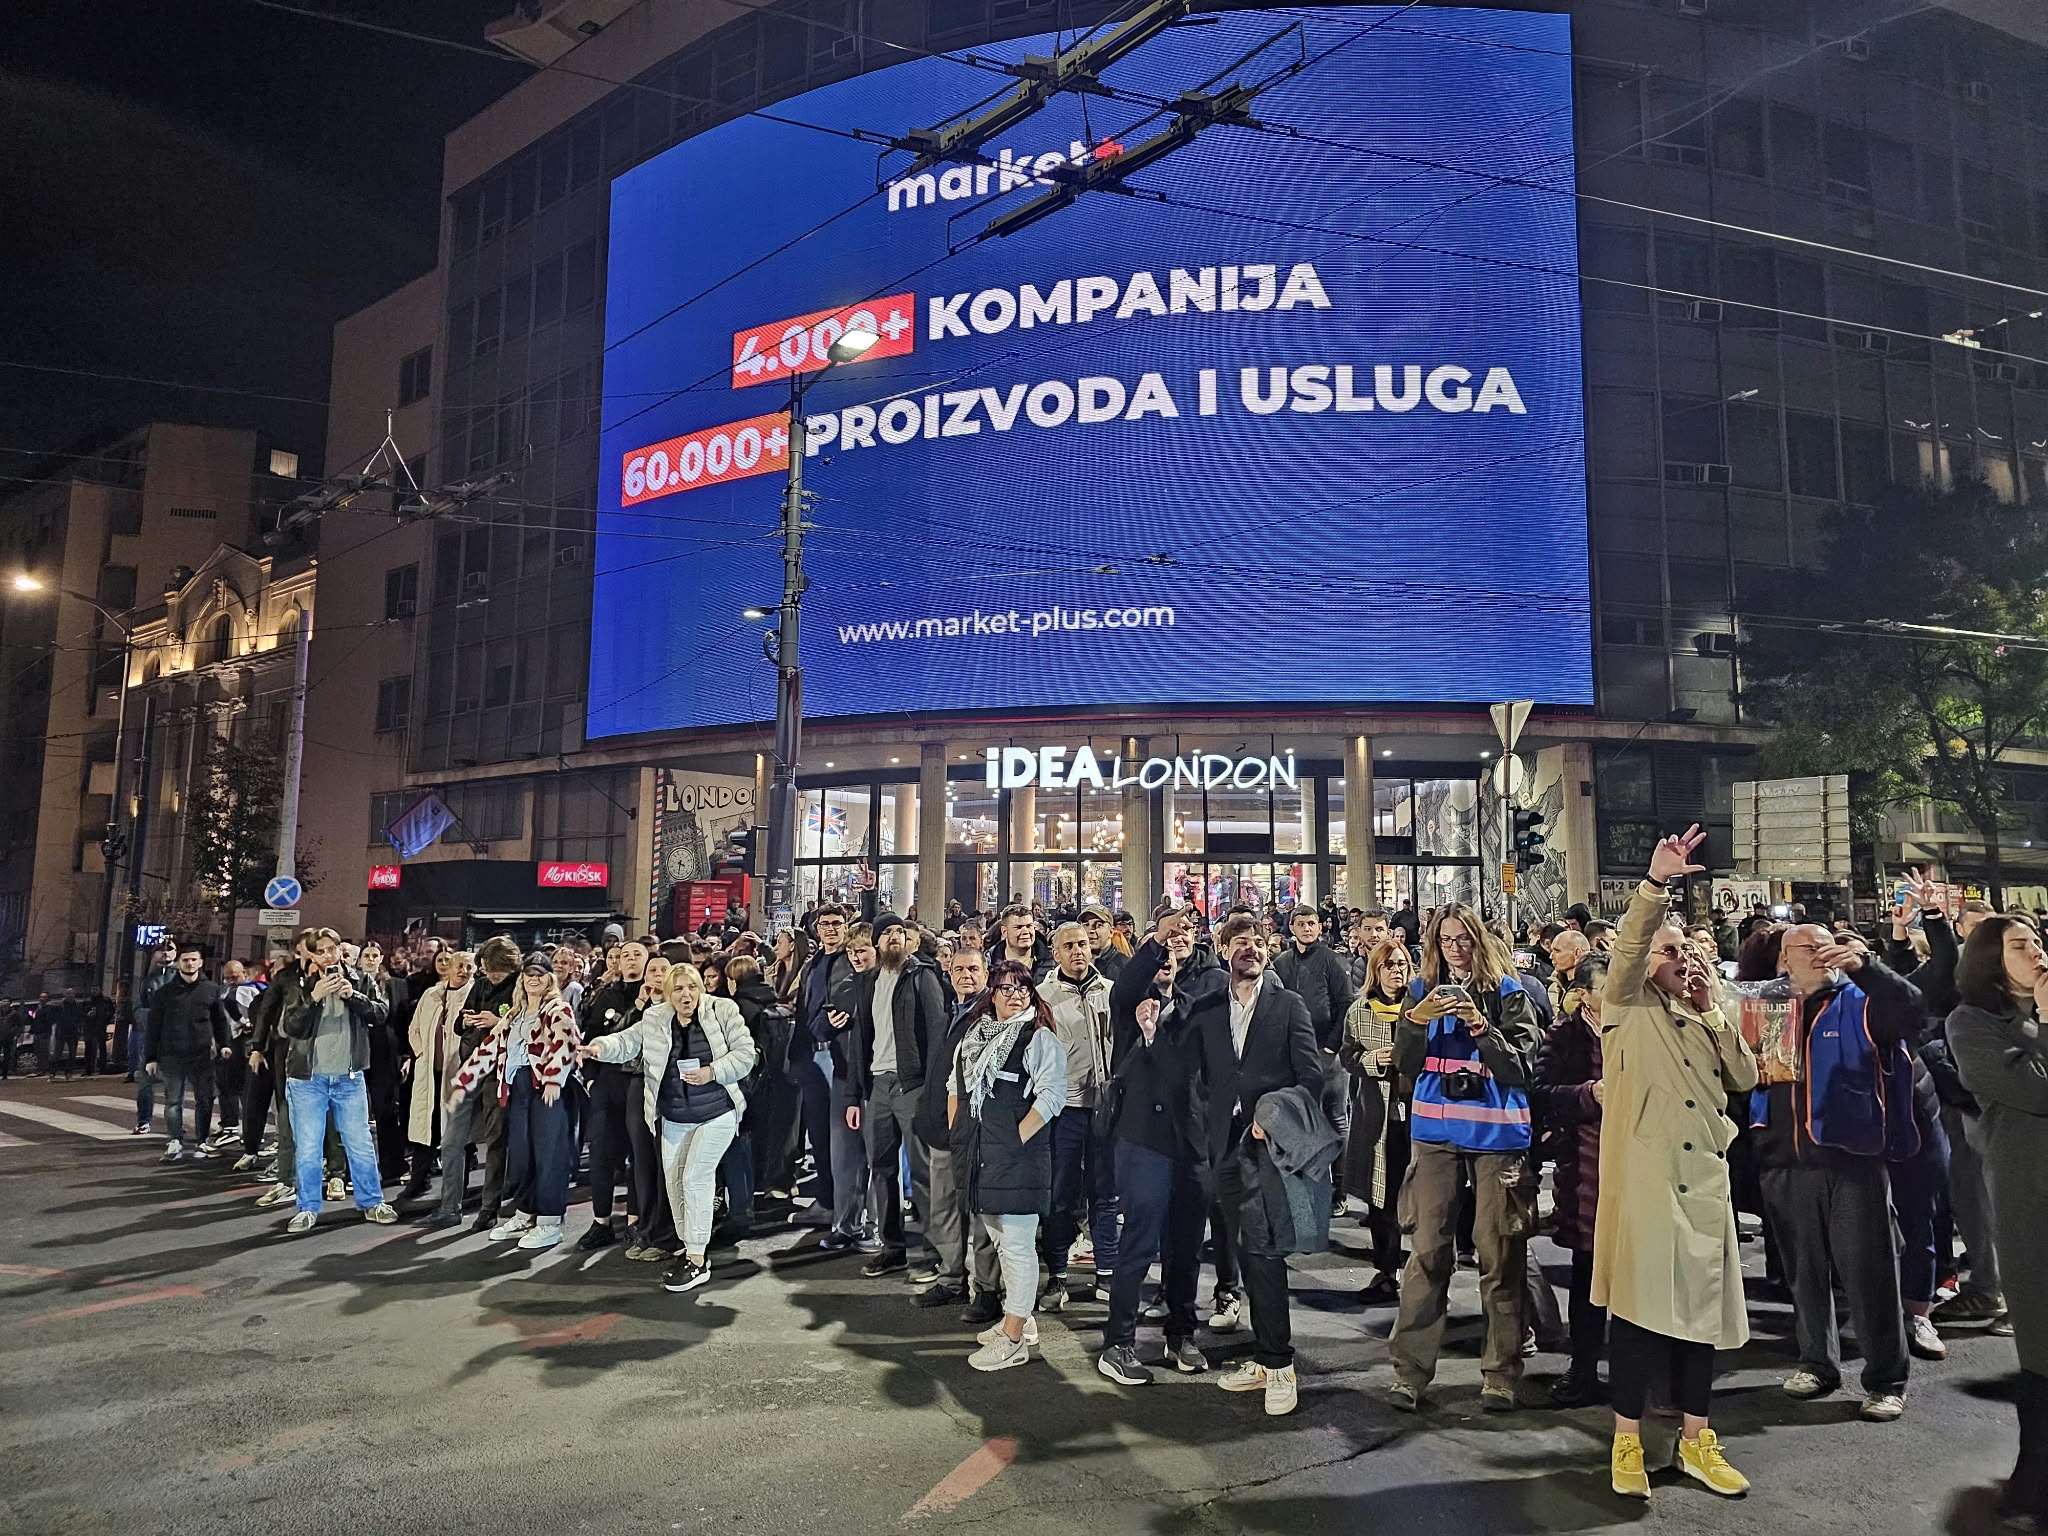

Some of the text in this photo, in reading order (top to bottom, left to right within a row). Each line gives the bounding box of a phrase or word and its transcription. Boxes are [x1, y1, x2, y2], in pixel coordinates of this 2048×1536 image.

[928, 263, 1332, 341] KOMPANIJA
[624, 364, 1528, 498] 60.000+ PROIZVODA I USLUGA
[838, 605, 1175, 645] www.market-plus.com
[1112, 754, 1296, 791] LONDON
[665, 784, 756, 812] LONDO
